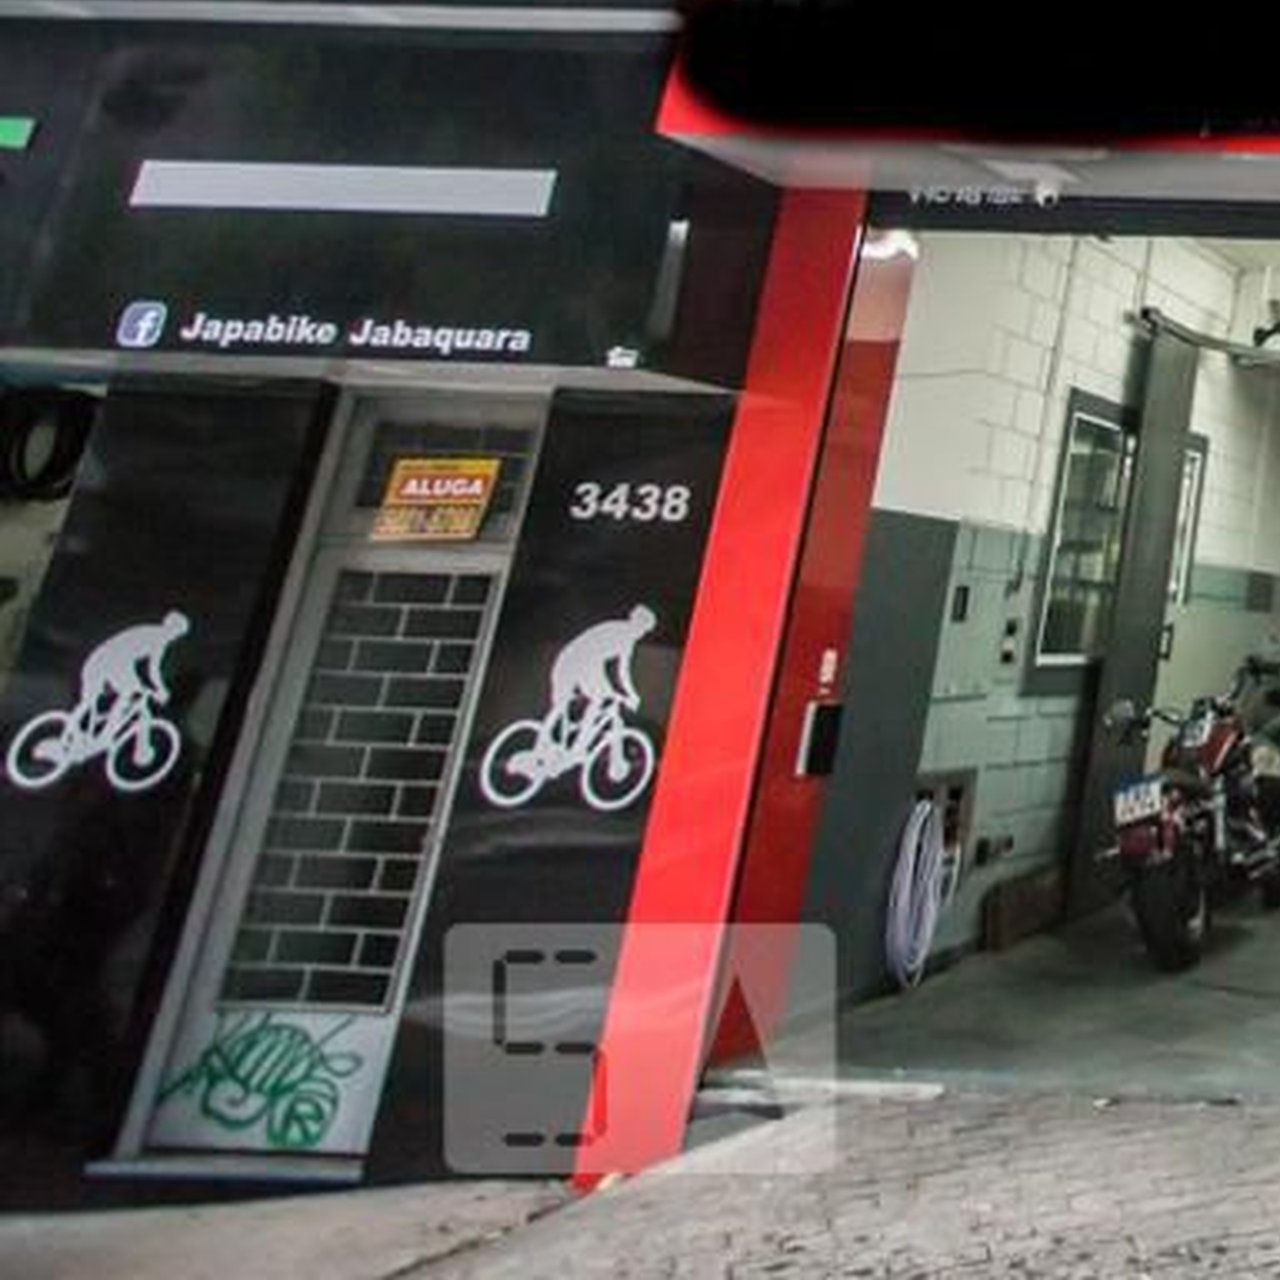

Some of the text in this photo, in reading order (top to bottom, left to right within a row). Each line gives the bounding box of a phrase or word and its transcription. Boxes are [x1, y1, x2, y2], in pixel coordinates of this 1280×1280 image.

[180, 313, 338, 347] Japabike
[349, 318, 531, 355] Jabaquara
[400, 478, 483, 496] ALUGA
[569, 481, 691, 521] 3438
